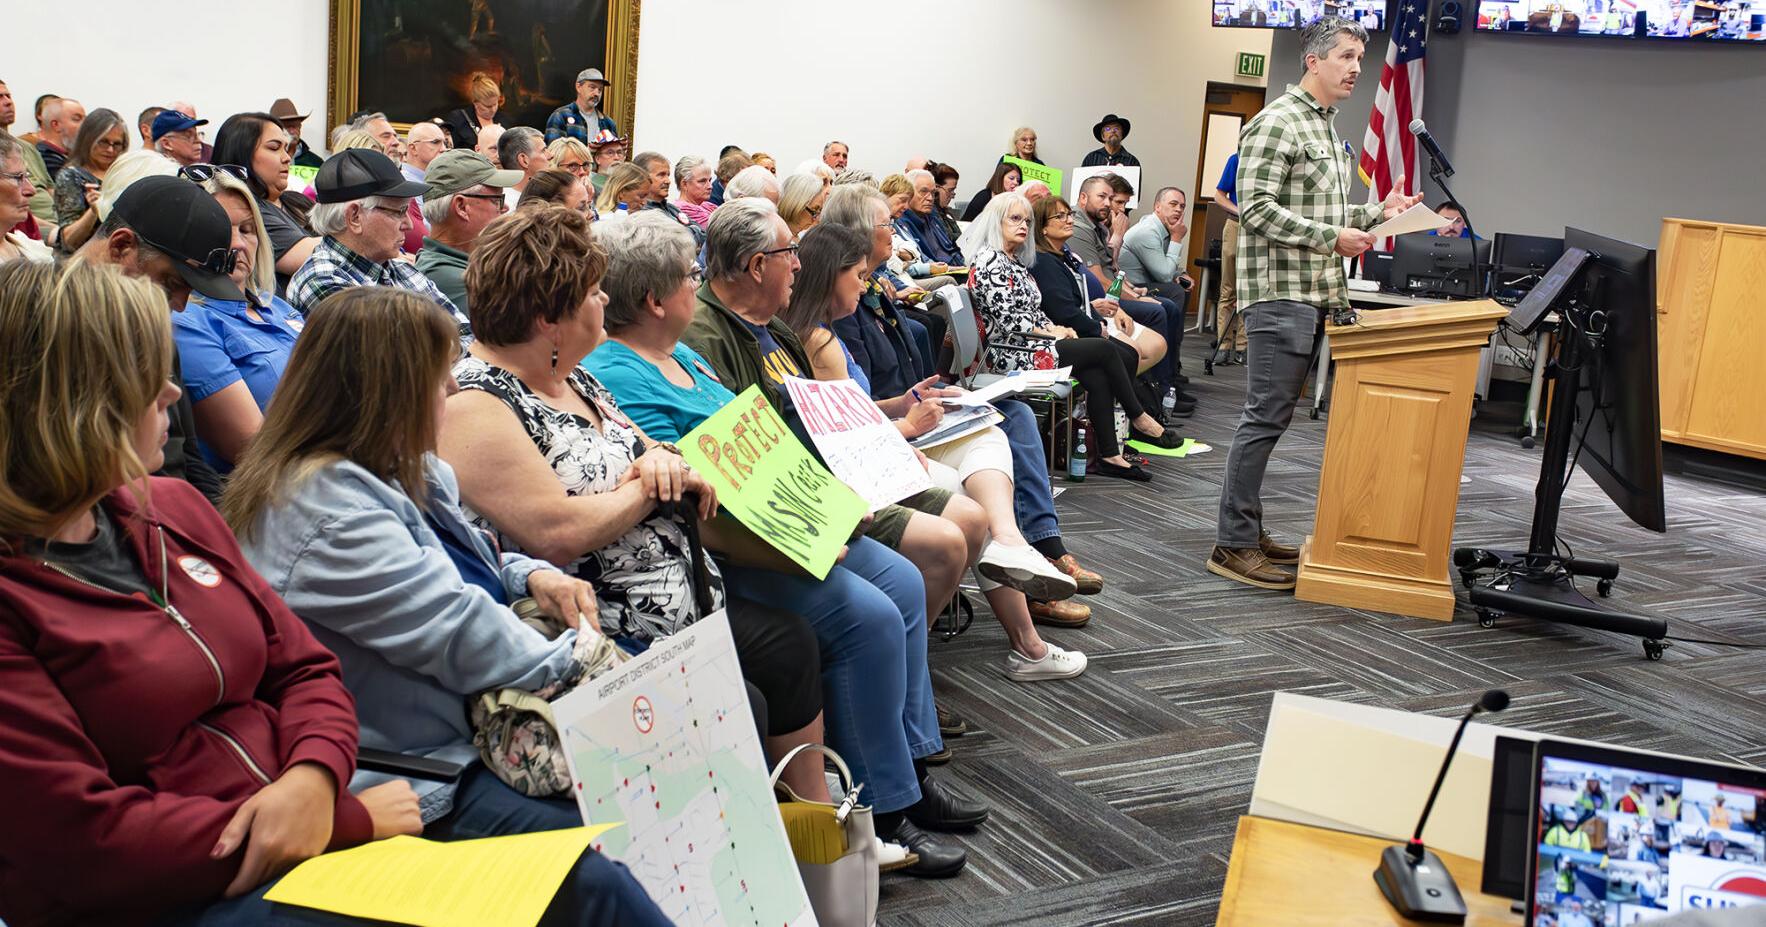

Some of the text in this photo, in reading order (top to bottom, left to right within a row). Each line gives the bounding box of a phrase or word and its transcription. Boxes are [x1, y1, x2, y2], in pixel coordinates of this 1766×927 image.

[1241, 55, 1263, 75] EXIT
[1022, 166, 1051, 181] OTECT
[762, 347, 799, 385] NAV
[788, 380, 882, 436] HAZARD
[698, 394, 786, 492] PROTECT
[598, 635, 696, 700] AIRPORT DISTRICT SOUTH MAP
